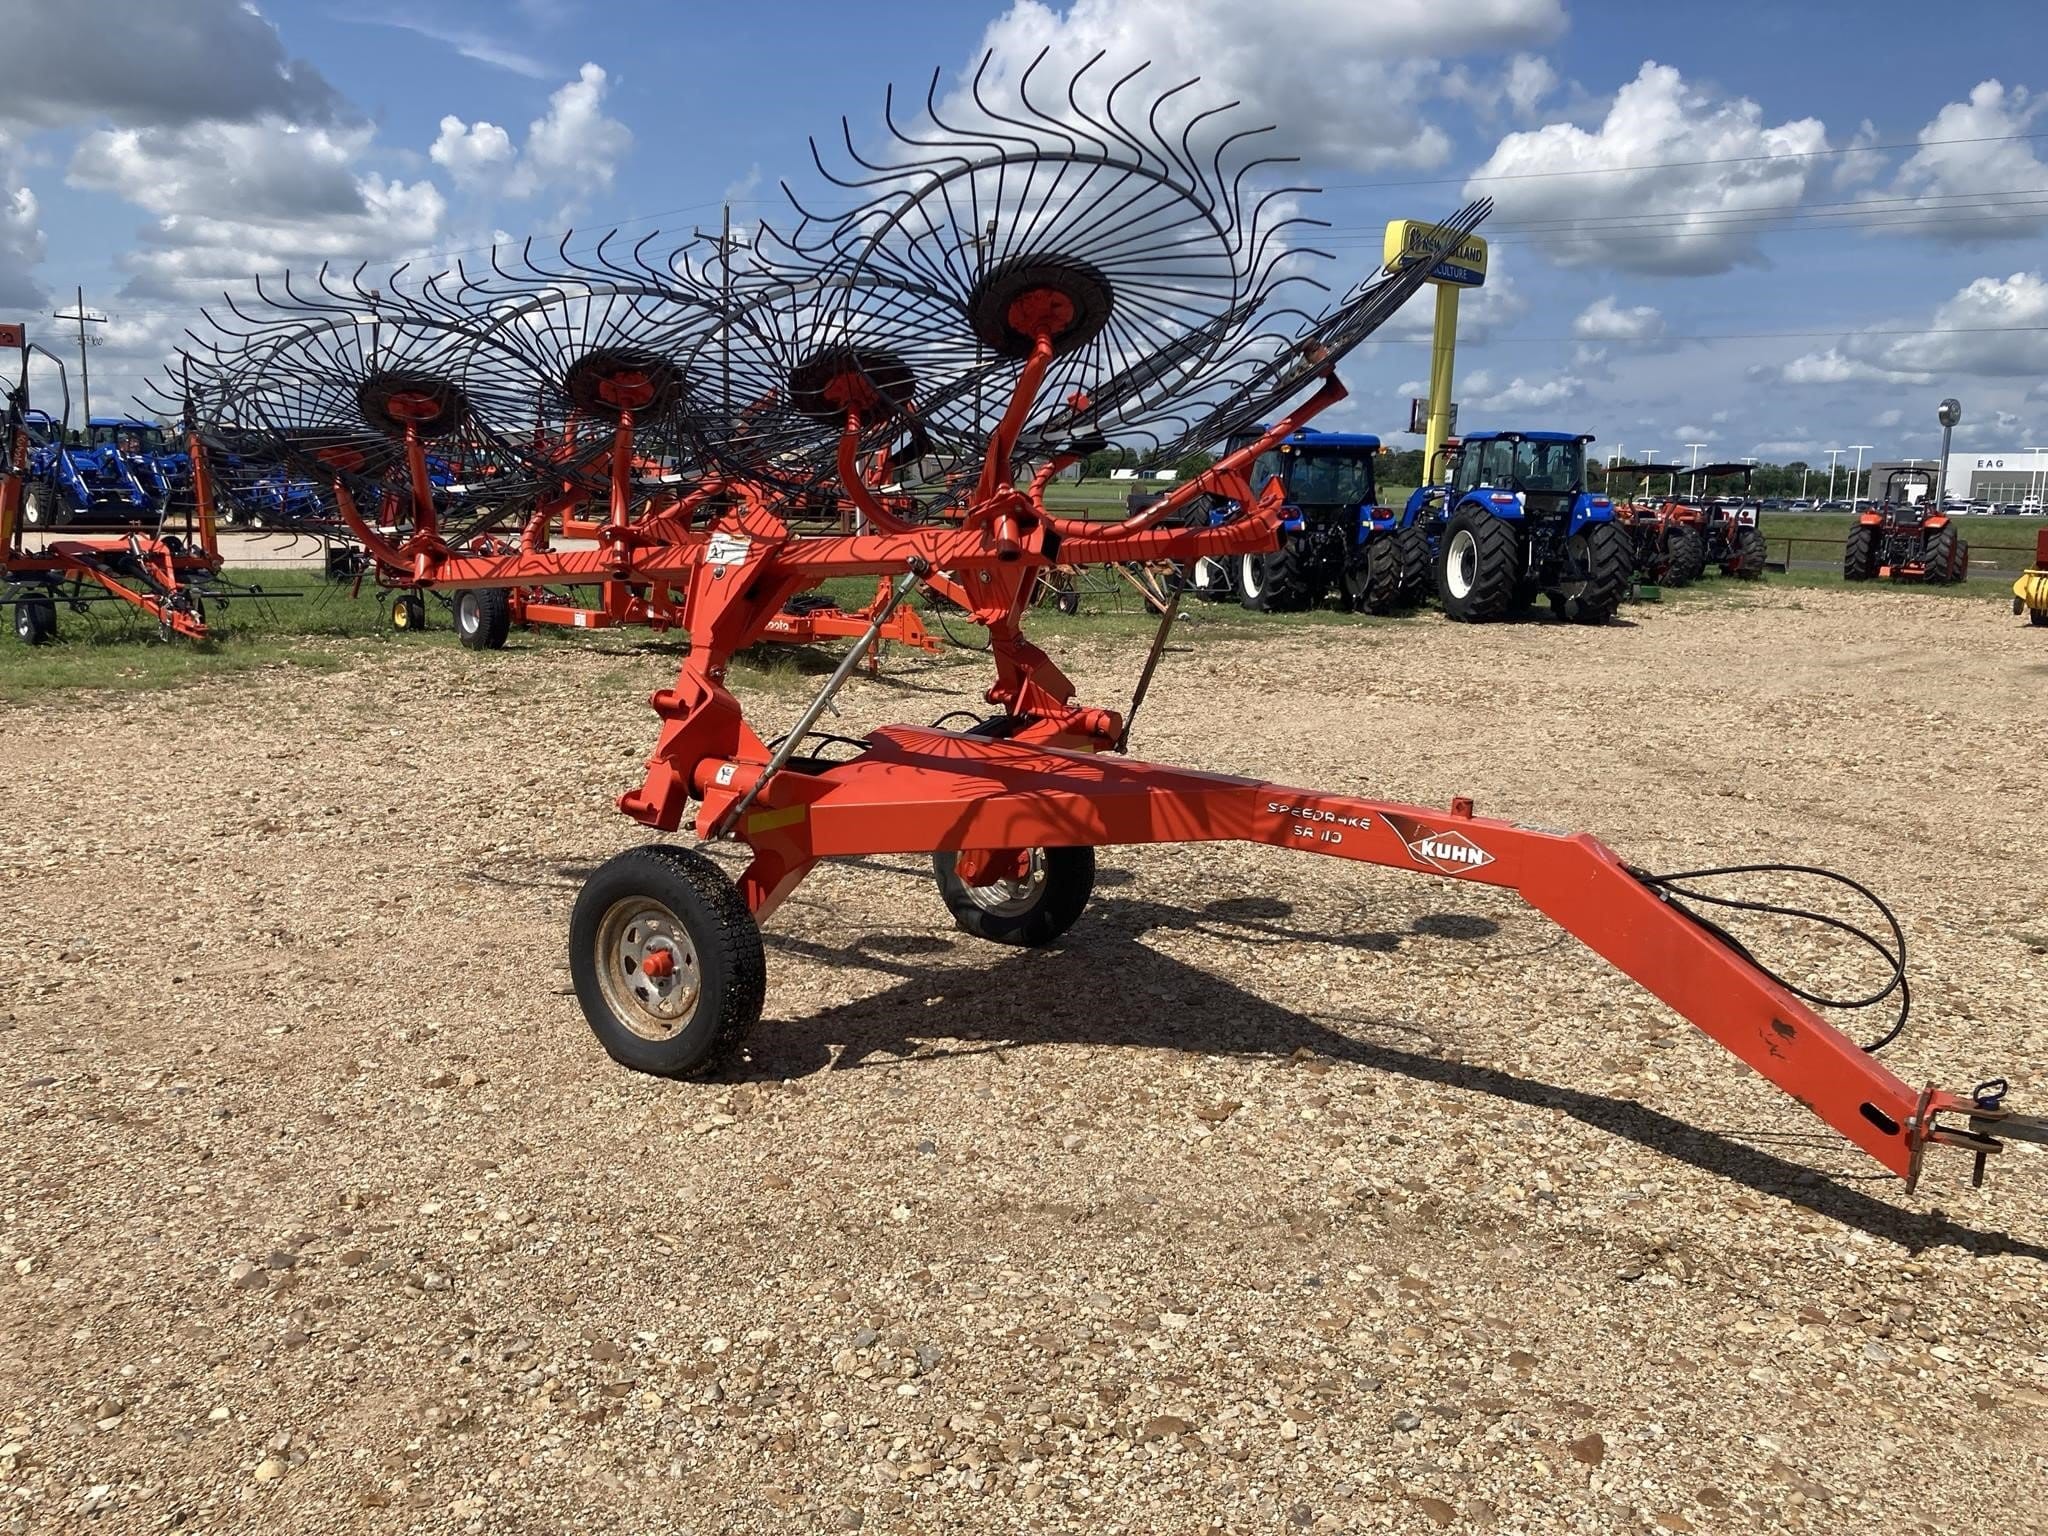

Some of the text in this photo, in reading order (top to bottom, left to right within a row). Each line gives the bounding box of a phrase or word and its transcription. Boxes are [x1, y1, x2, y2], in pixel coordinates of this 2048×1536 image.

[1421, 237, 1441, 252] NEW
[1436, 267, 1467, 279] CULTURE
[1977, 459, 2004, 468] EAG
[1266, 802, 1371, 830] SPEEDRAKE
[1294, 825, 1342, 844] SR 110
[1421, 839, 1483, 865] KUHN
